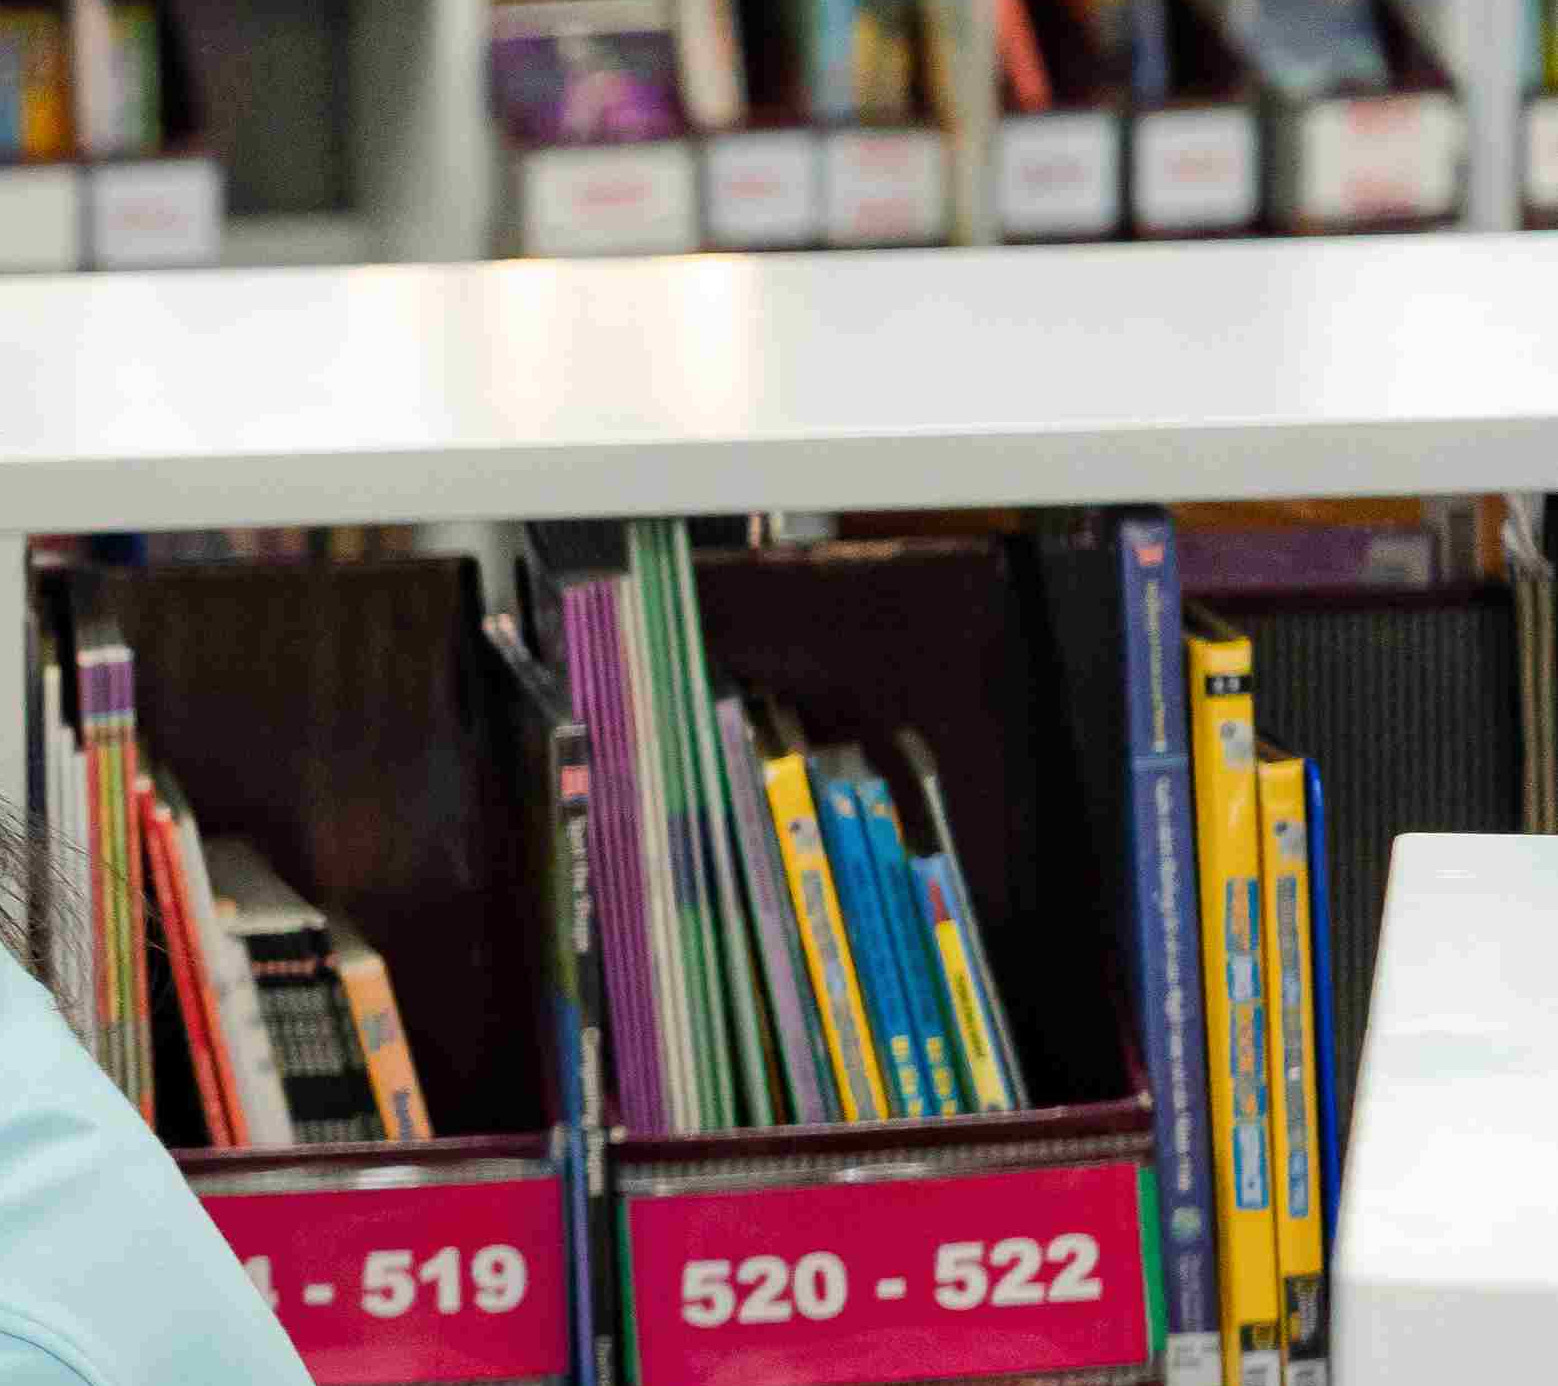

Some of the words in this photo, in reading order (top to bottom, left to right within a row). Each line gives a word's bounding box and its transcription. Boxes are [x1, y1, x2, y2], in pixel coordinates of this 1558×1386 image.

[301, 1281, 336, 1307] -
[359, 1243, 529, 1318] 519
[679, 1250, 849, 1329] 520
[874, 1276, 908, 1301] -
[933, 1232, 1104, 1311] 522
